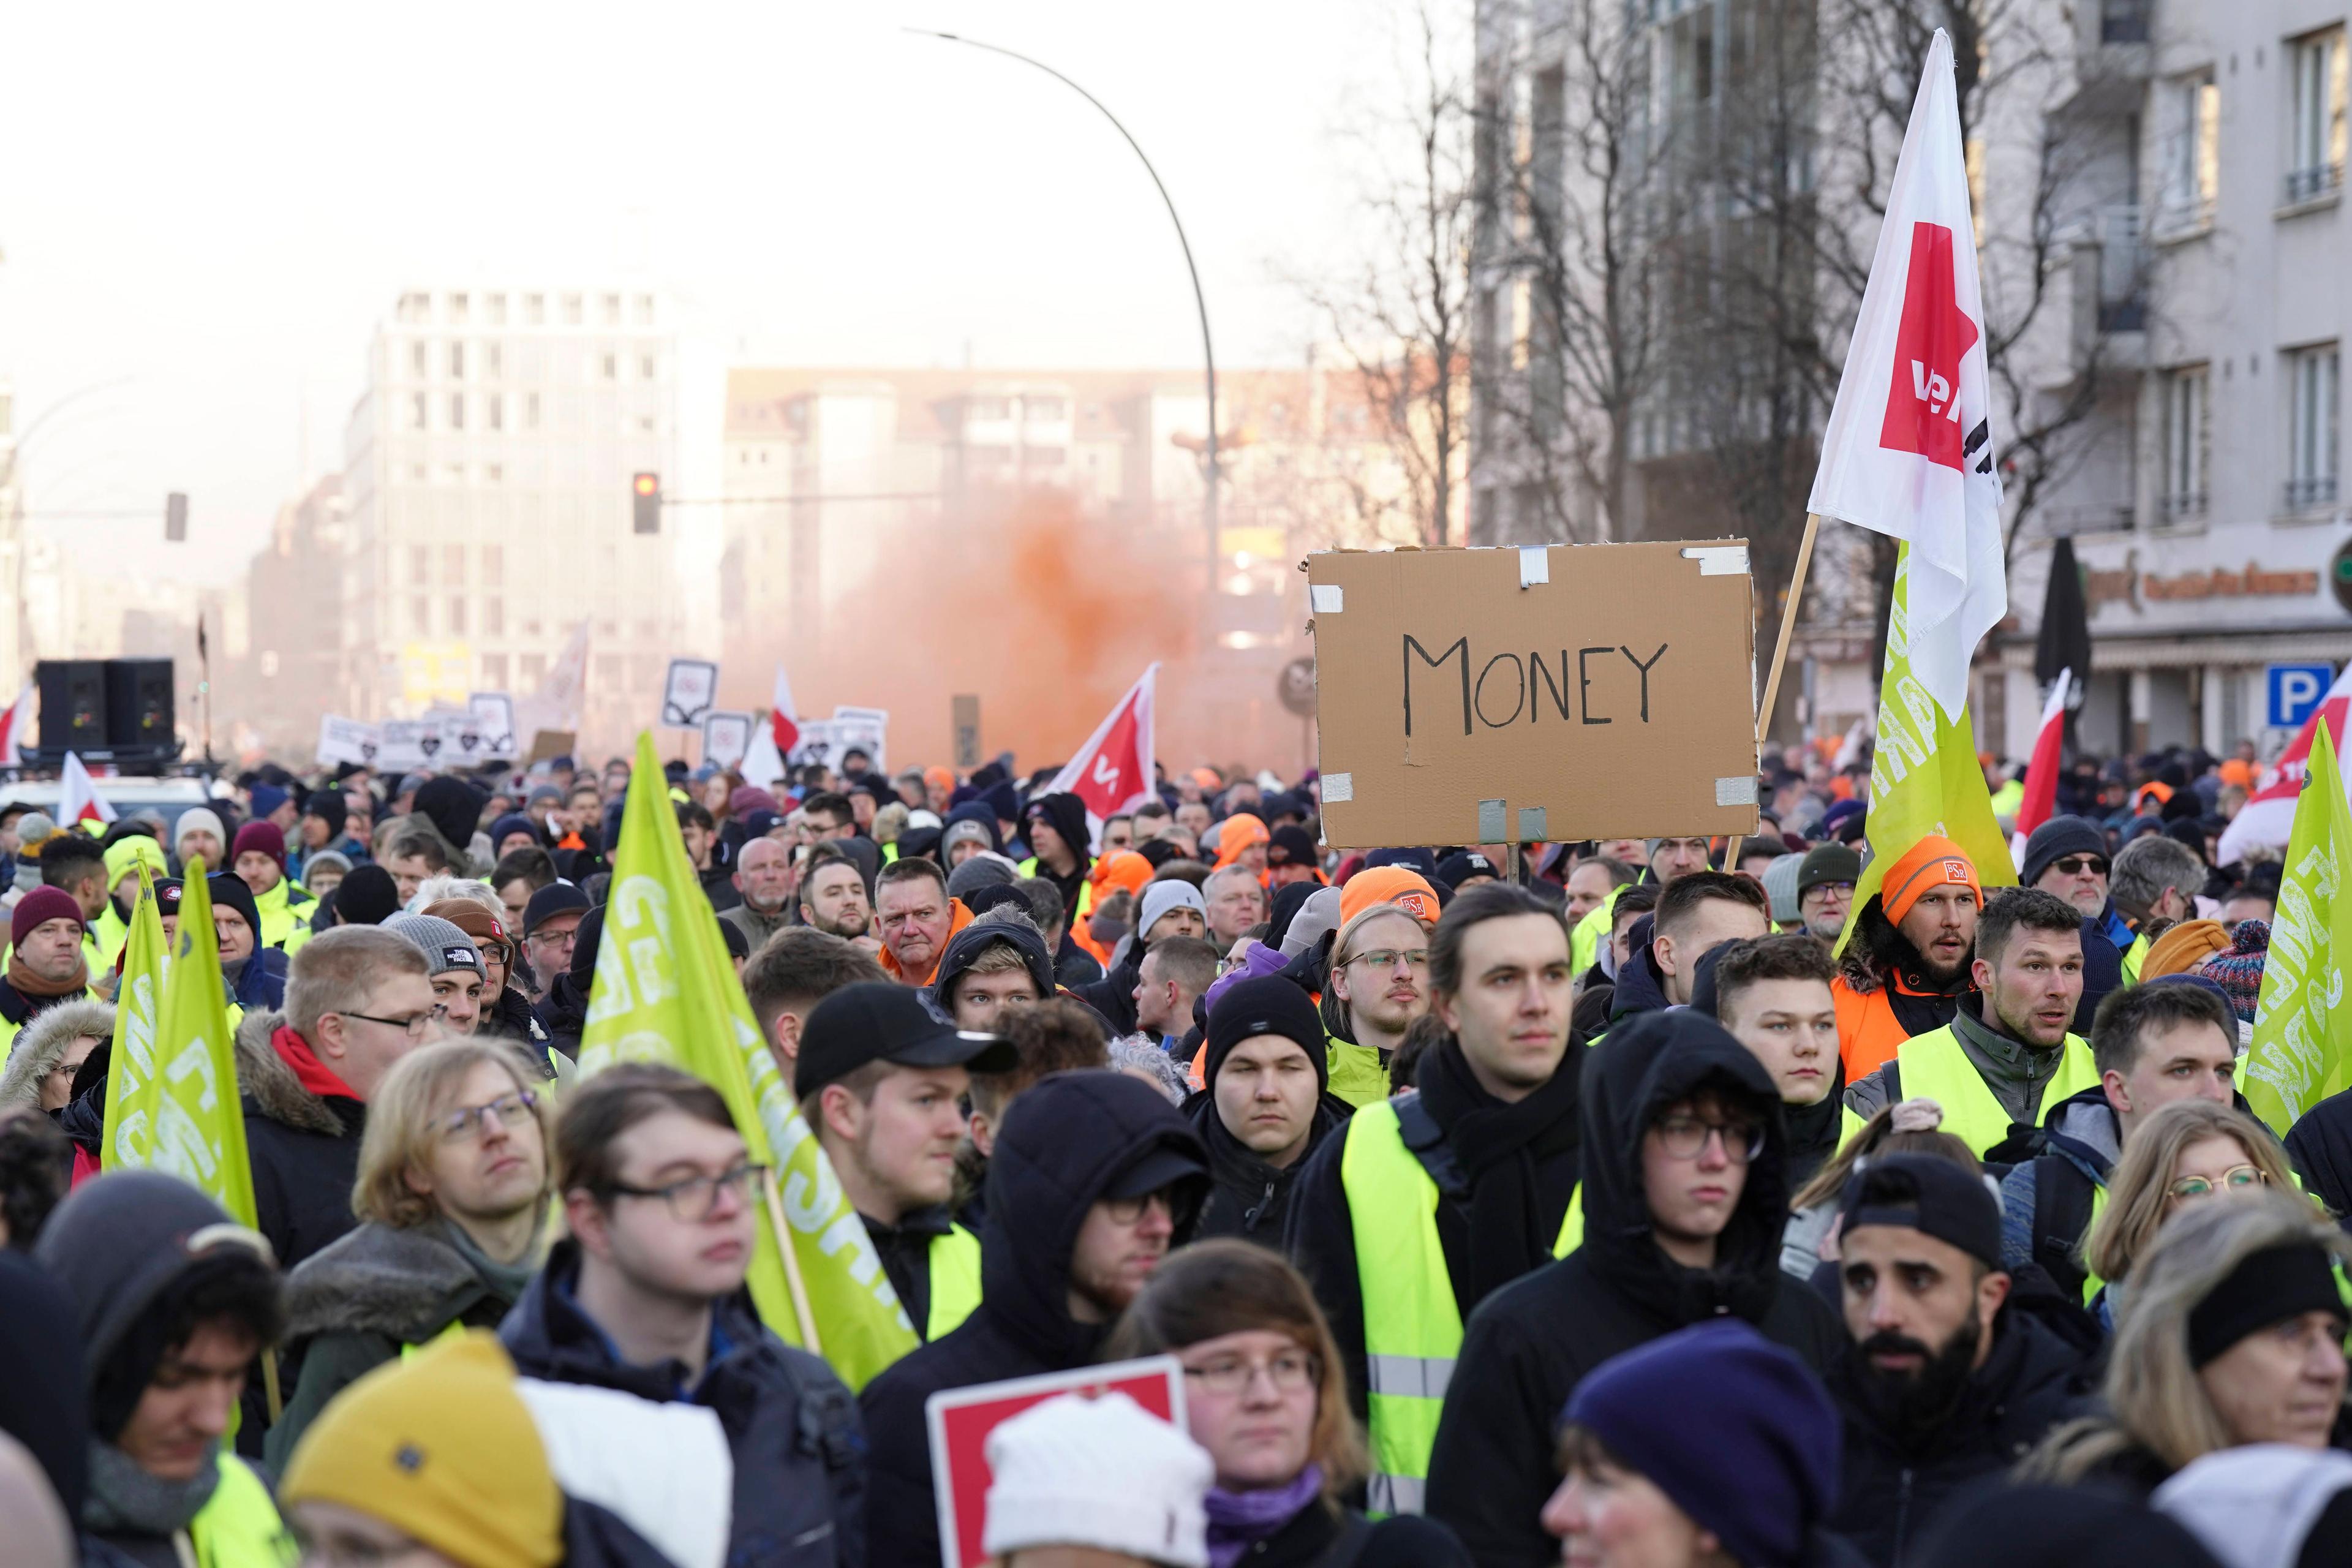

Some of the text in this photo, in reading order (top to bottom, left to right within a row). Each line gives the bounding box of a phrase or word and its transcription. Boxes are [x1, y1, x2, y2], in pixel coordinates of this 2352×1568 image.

[1404, 634, 1668, 737] MONEY
[2280, 671, 2320, 722] P
[1947, 864, 1966, 878] BSR
[1404, 899, 1423, 913] BSR
